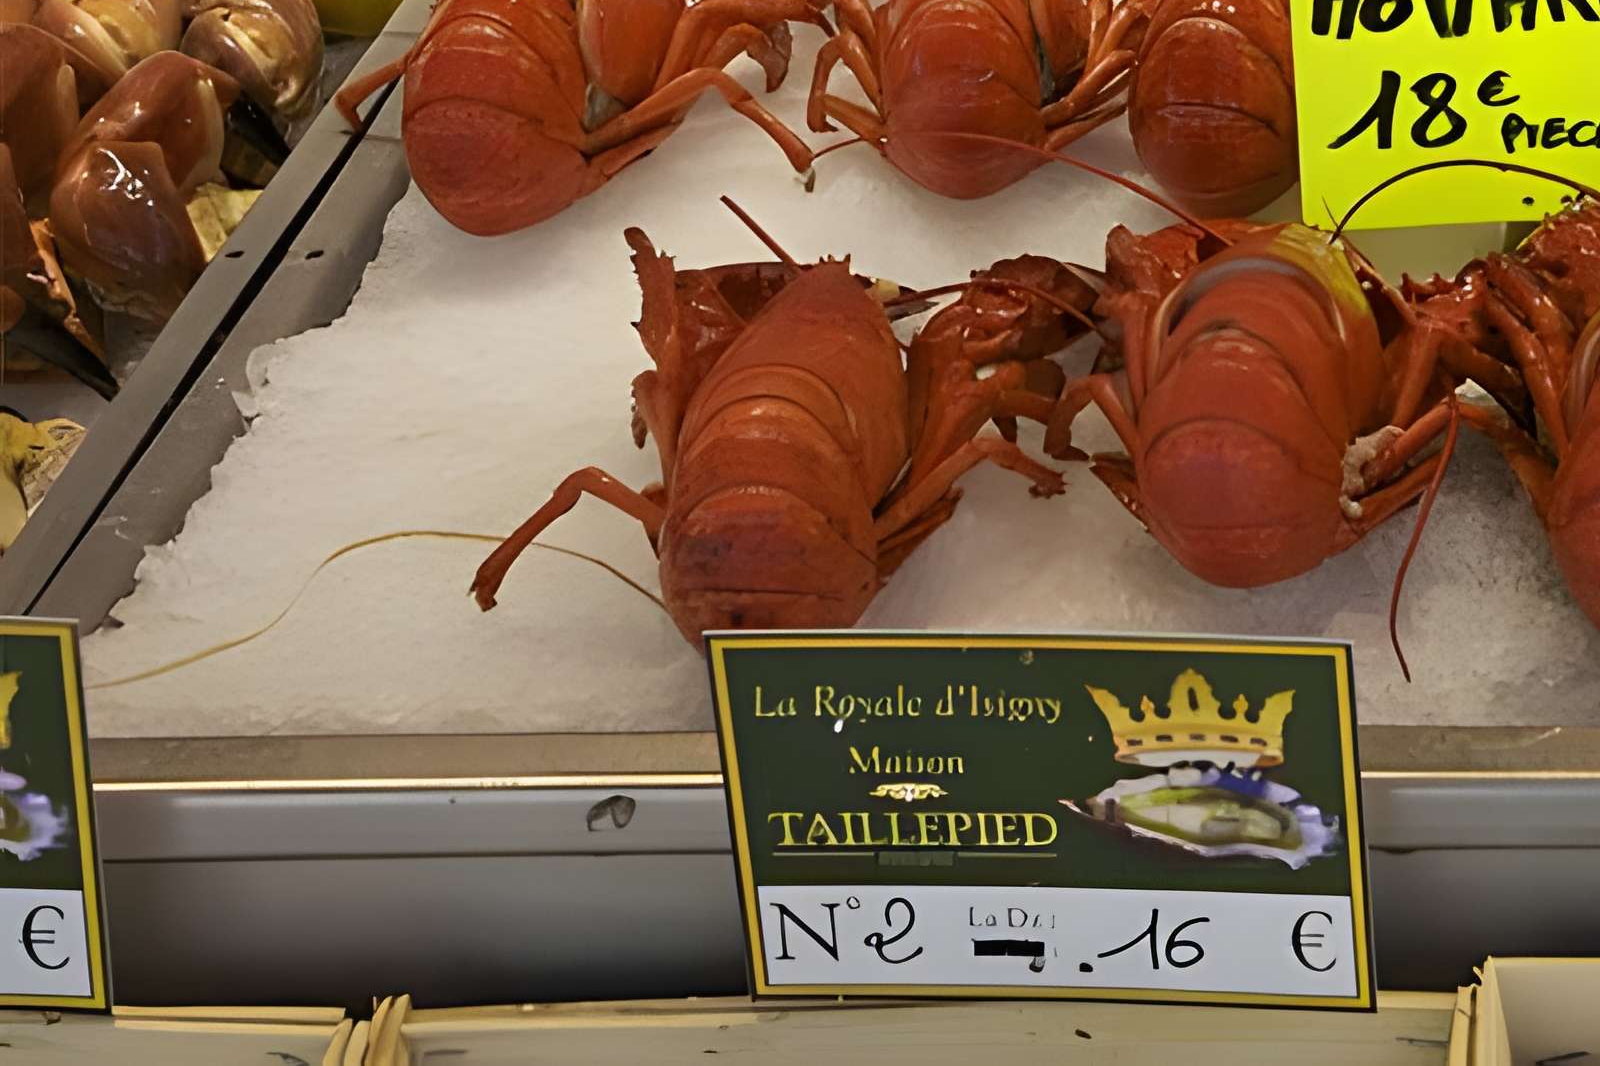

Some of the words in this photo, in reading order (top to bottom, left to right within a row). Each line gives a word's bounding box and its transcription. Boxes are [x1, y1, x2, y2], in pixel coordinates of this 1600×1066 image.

[755, 685, 797, 718] La
[814, 684, 922, 724] Royale
[848, 745, 965, 775] Maison
[767, 811, 1059, 847] TAILLEPIED
[22, 904, 71, 970] €
[1290, 910, 1338, 973] €
